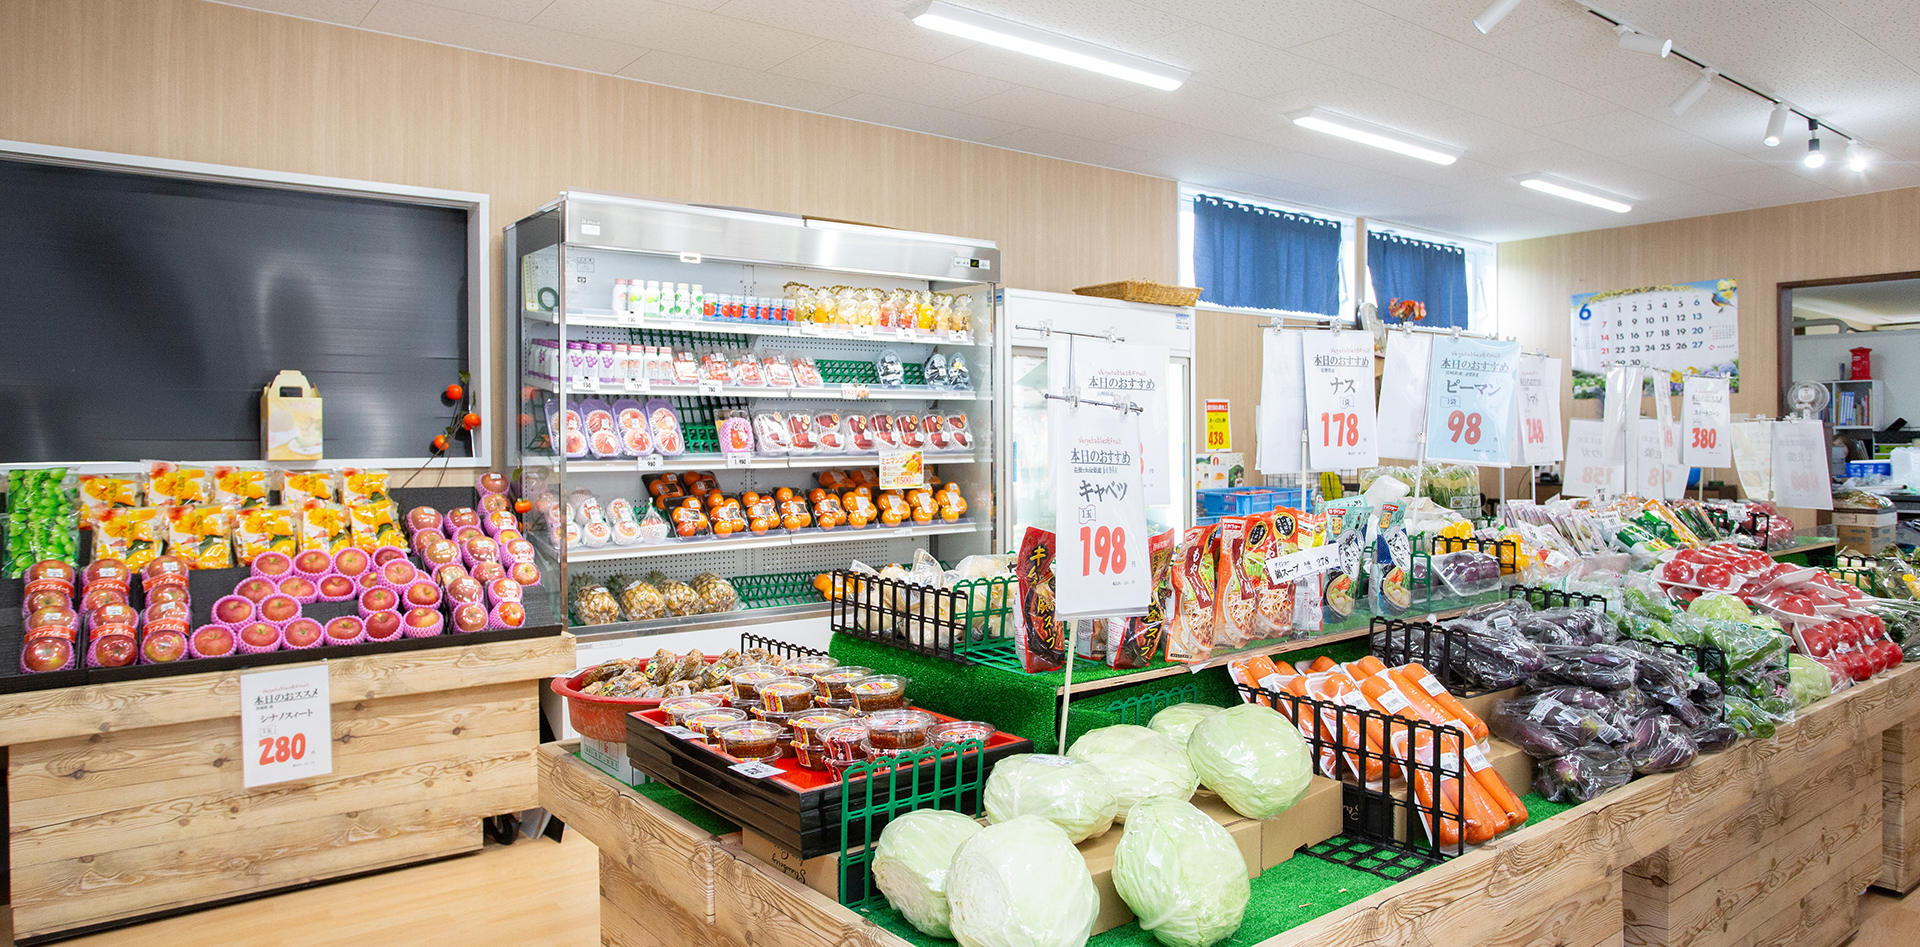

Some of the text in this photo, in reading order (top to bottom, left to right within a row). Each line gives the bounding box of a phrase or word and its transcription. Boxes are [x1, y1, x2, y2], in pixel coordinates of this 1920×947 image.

[1579, 303, 1591, 320] 6
[1676, 342, 1687, 350] 26
[1314, 354, 1369, 367] 本日のおすすめ
[1441, 358, 1510, 372] 本日のおすすめ
[1089, 376, 1155, 390] 本日のおすすめ
[1330, 377, 1356, 395] ナス
[1447, 380, 1501, 396] ピーマン
[1526, 393, 1538, 406] トマト
[1321, 412, 1358, 446] 178
[1448, 410, 1482, 445] 98
[1526, 418, 1544, 444] 248
[1209, 432, 1224, 446] 438
[1692, 427, 1716, 449] 380
[882, 457, 907, 465] ミニマンゴー
[1071, 448, 1131, 464] 本日のおすすめ
[1080, 480, 1128, 502] キャベツ
[1080, 526, 1127, 576] 198
[1274, 564, 1299, 580] 鍋スープ
[1316, 556, 1330, 566] 278
[31, 583, 72, 594] シナノスイート
[88, 582, 127, 593] シナノスイート
[156, 577, 188, 588] シナノスイート
[30, 630, 71, 641] シナノスイート
[97, 626, 133, 638] シナノスイート
[150, 622, 187, 634] シナノスイート
[254, 688, 318, 706] 本日のおススメ
[259, 733, 306, 766] 280
